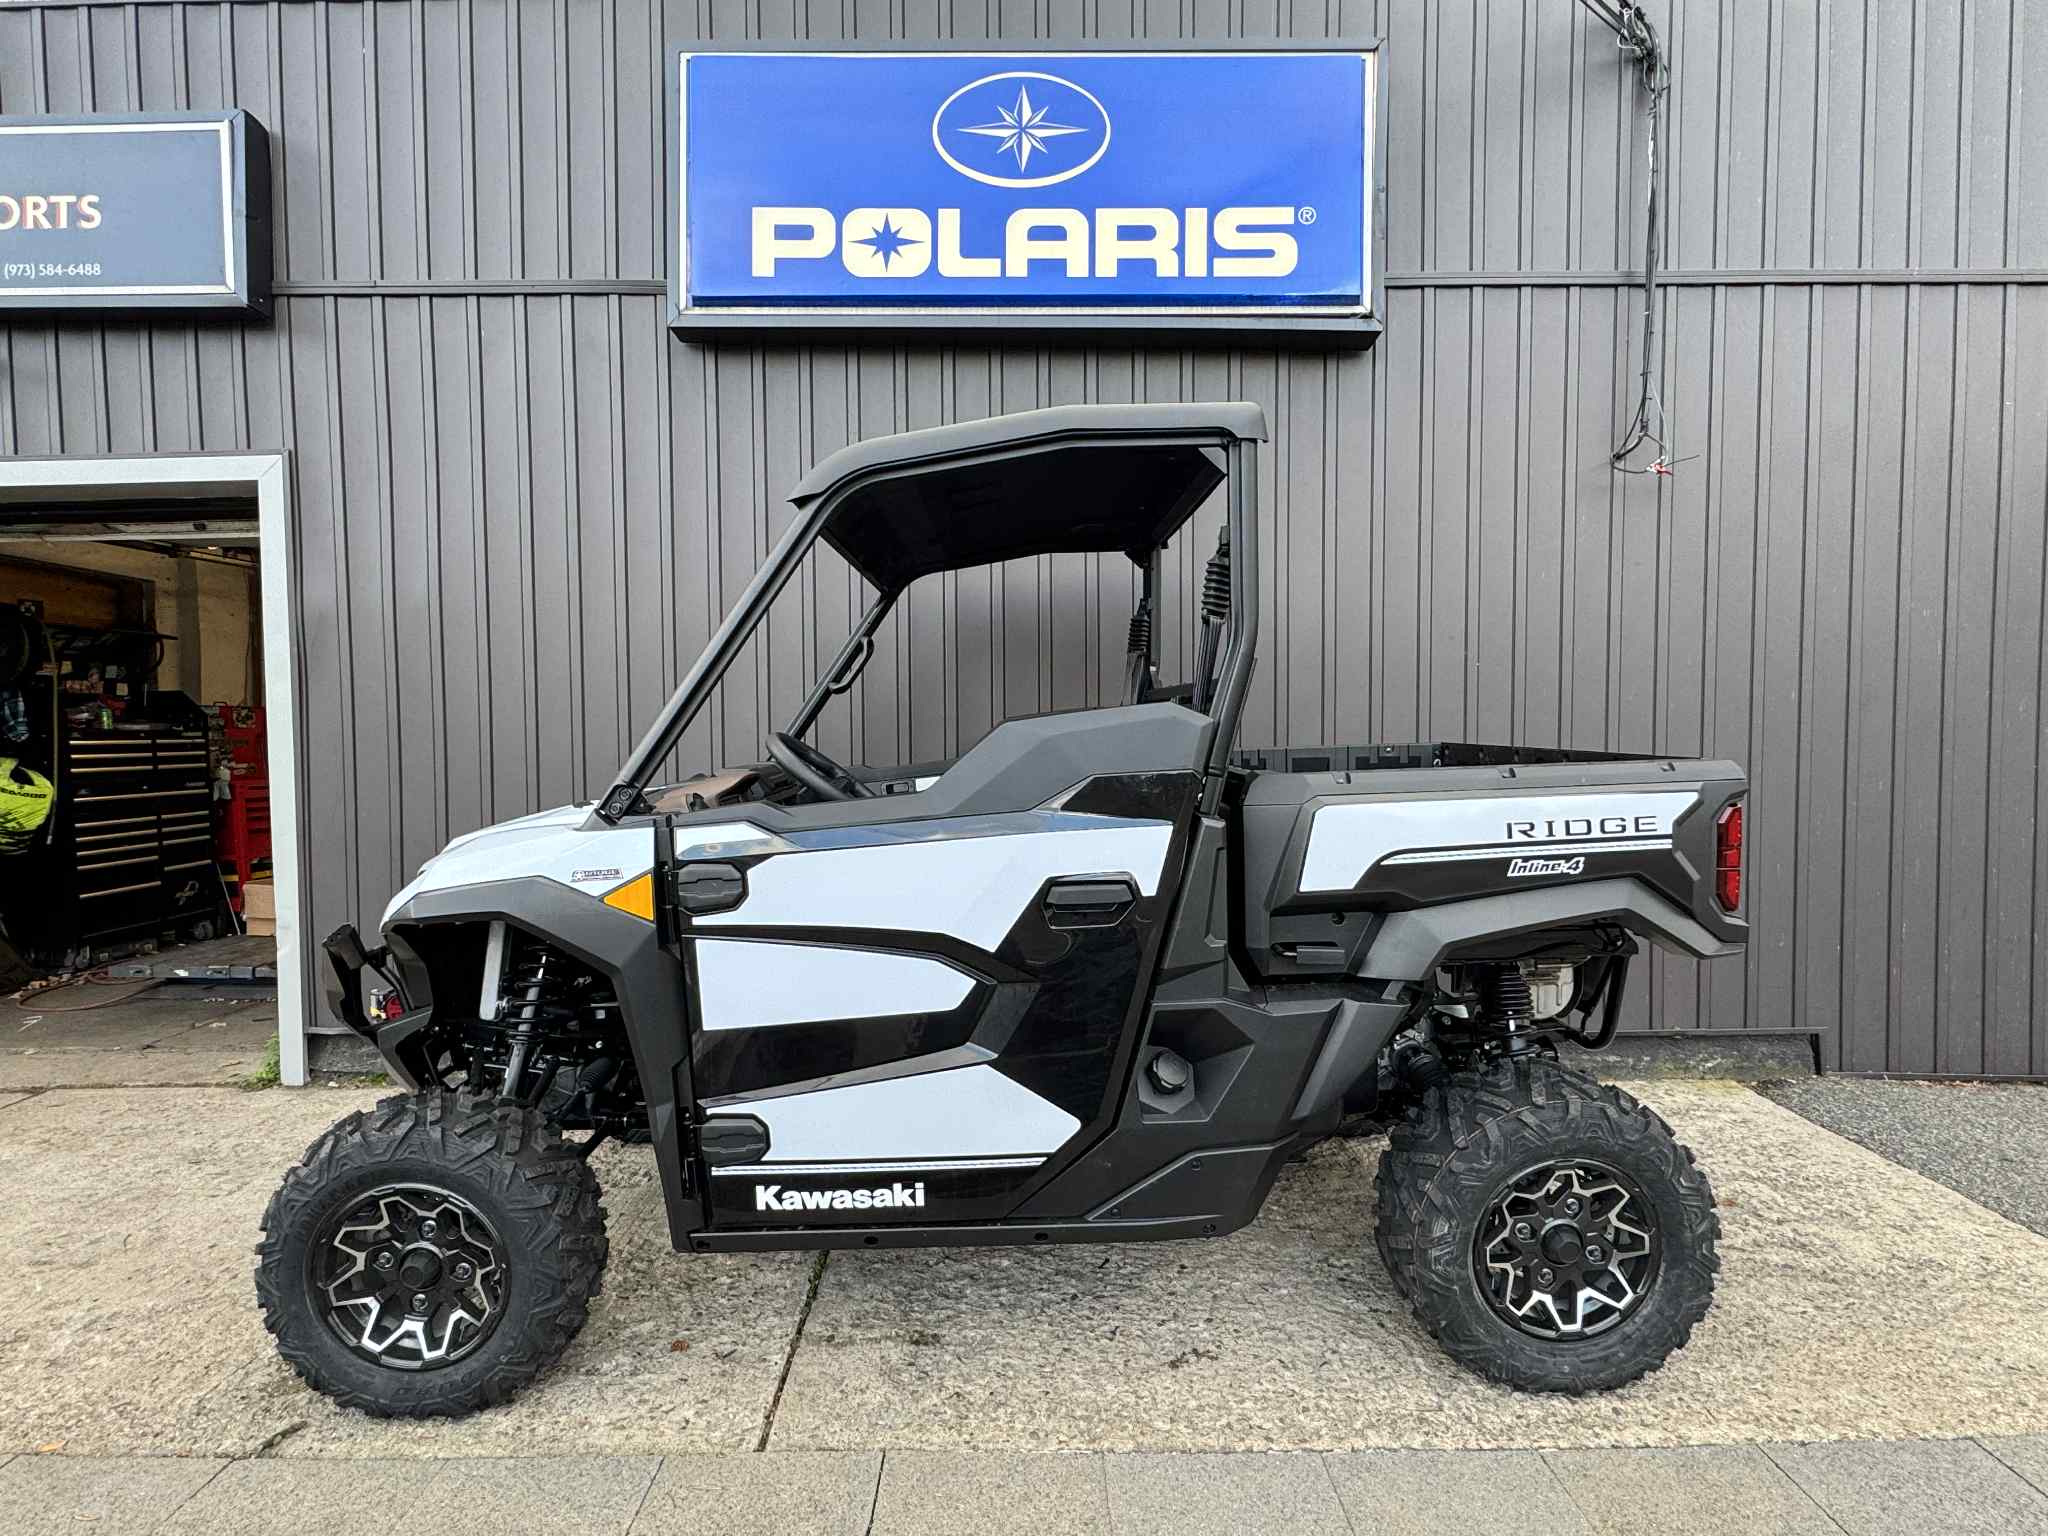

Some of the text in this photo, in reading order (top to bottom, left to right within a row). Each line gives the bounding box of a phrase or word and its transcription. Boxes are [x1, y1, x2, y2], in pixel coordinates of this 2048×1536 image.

[4, 262, 102, 280] (973) 584-6488
[1506, 815, 1658, 839] RIDGE
[1508, 857, 1585, 877] Inline-4
[755, 1182, 925, 1211] Kawasaki
